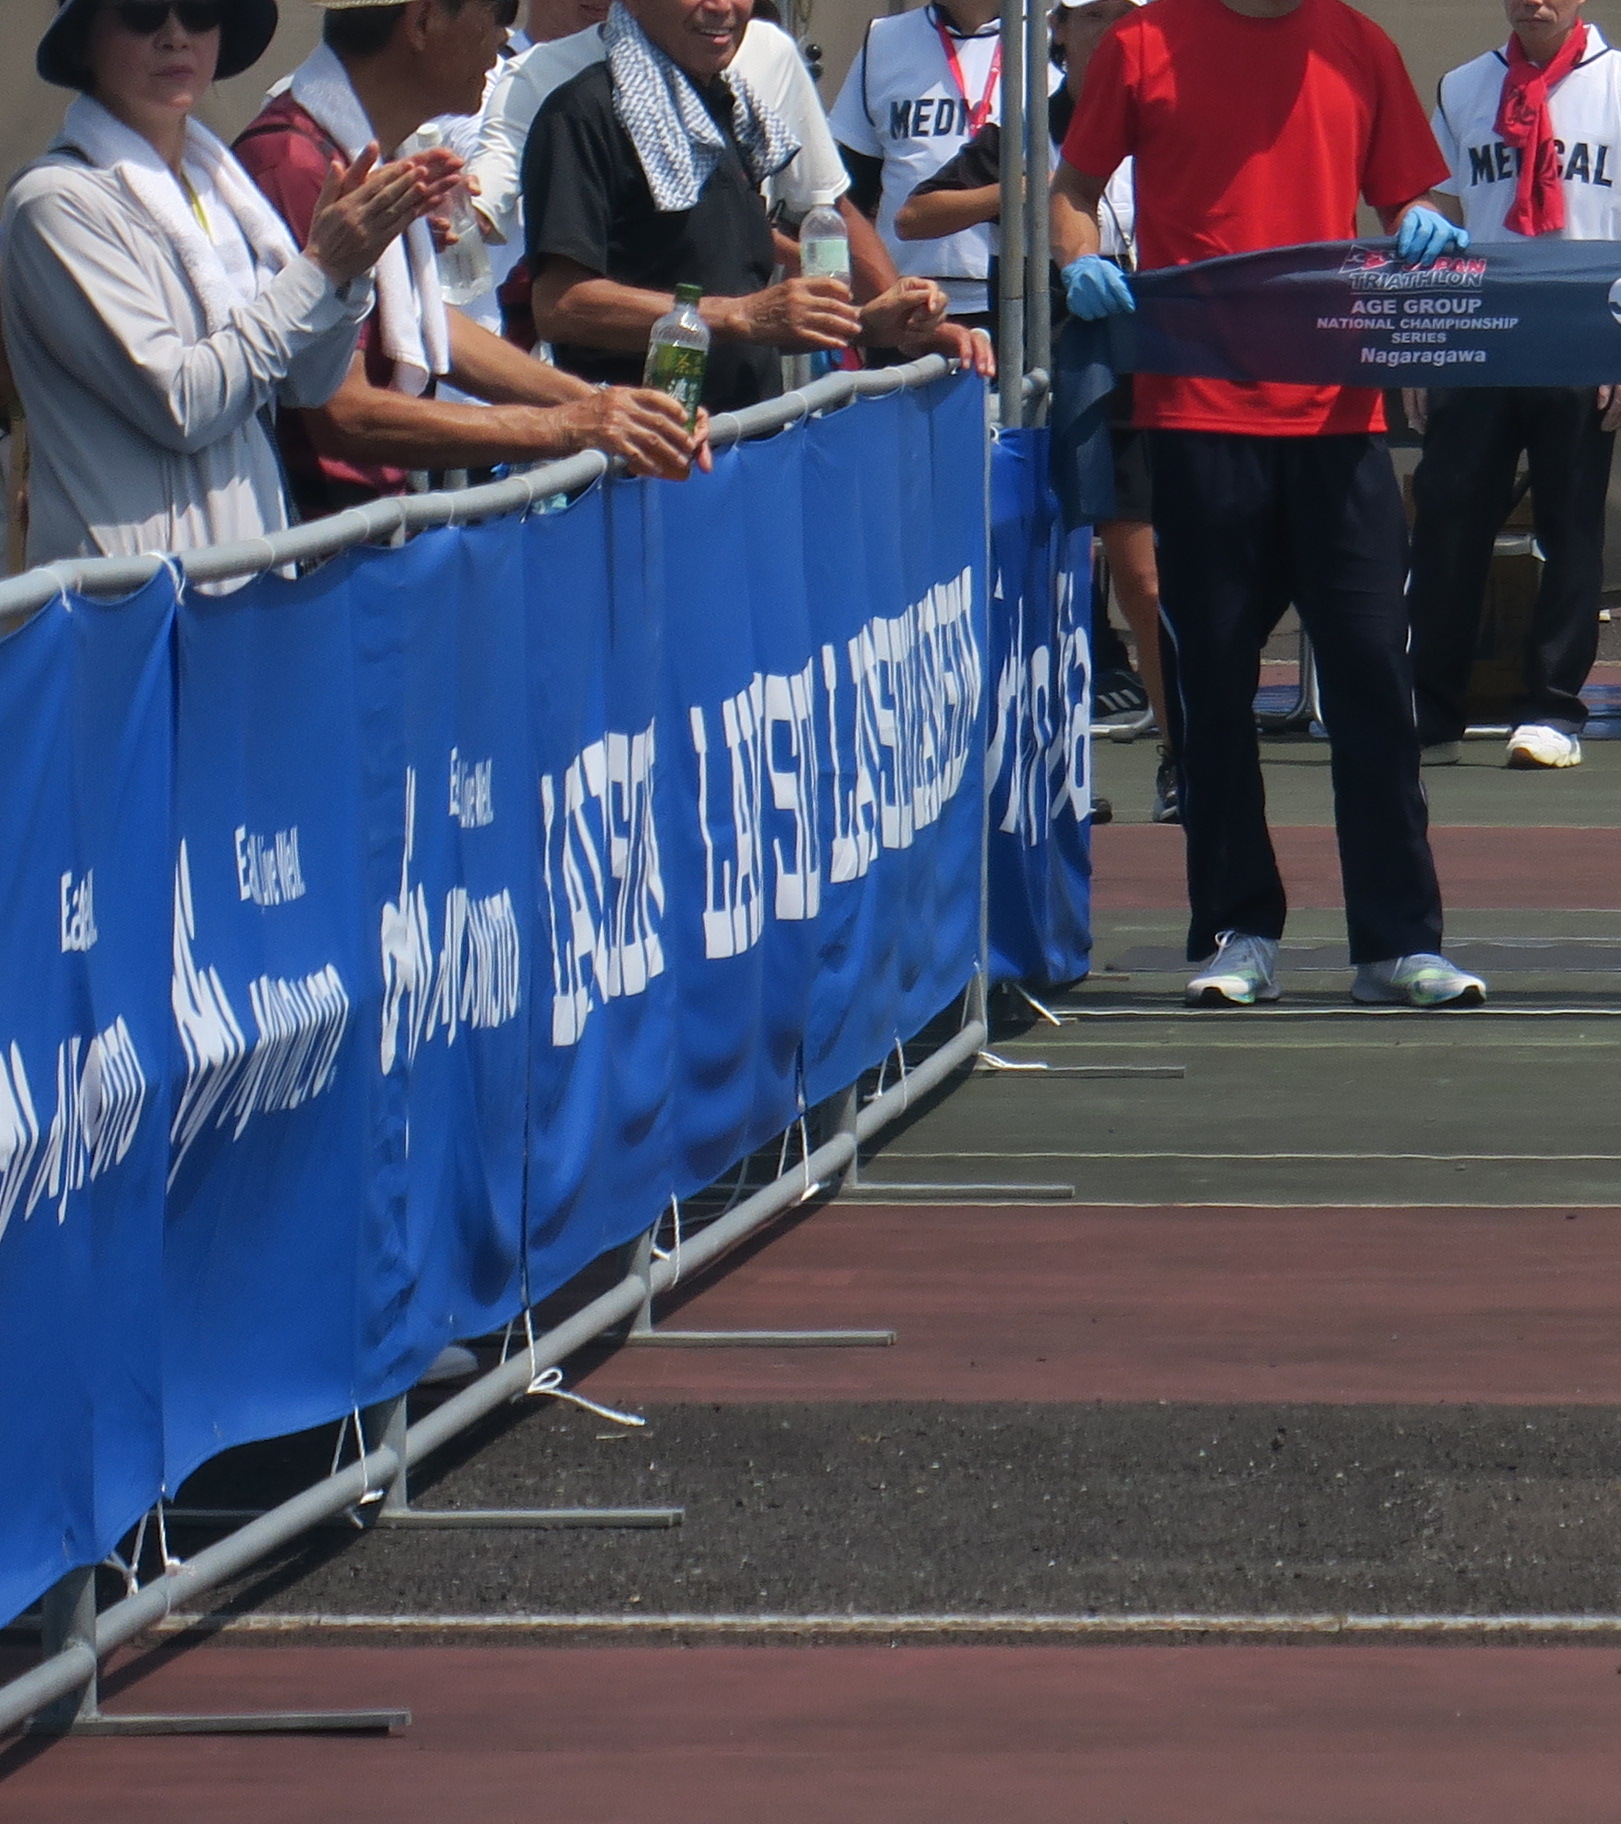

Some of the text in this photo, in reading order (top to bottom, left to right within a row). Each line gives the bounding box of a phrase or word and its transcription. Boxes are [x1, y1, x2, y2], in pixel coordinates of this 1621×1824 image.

[1350, 271, 1485, 290] TRIATHLON
[1352, 298, 1483, 315] AGE GROUP
[1317, 317, 1519, 330] NATIONAL CHAMPIONSHIP
[1391, 332, 1447, 344] SERIES
[1360, 347, 1487, 368] Nagaragawa
